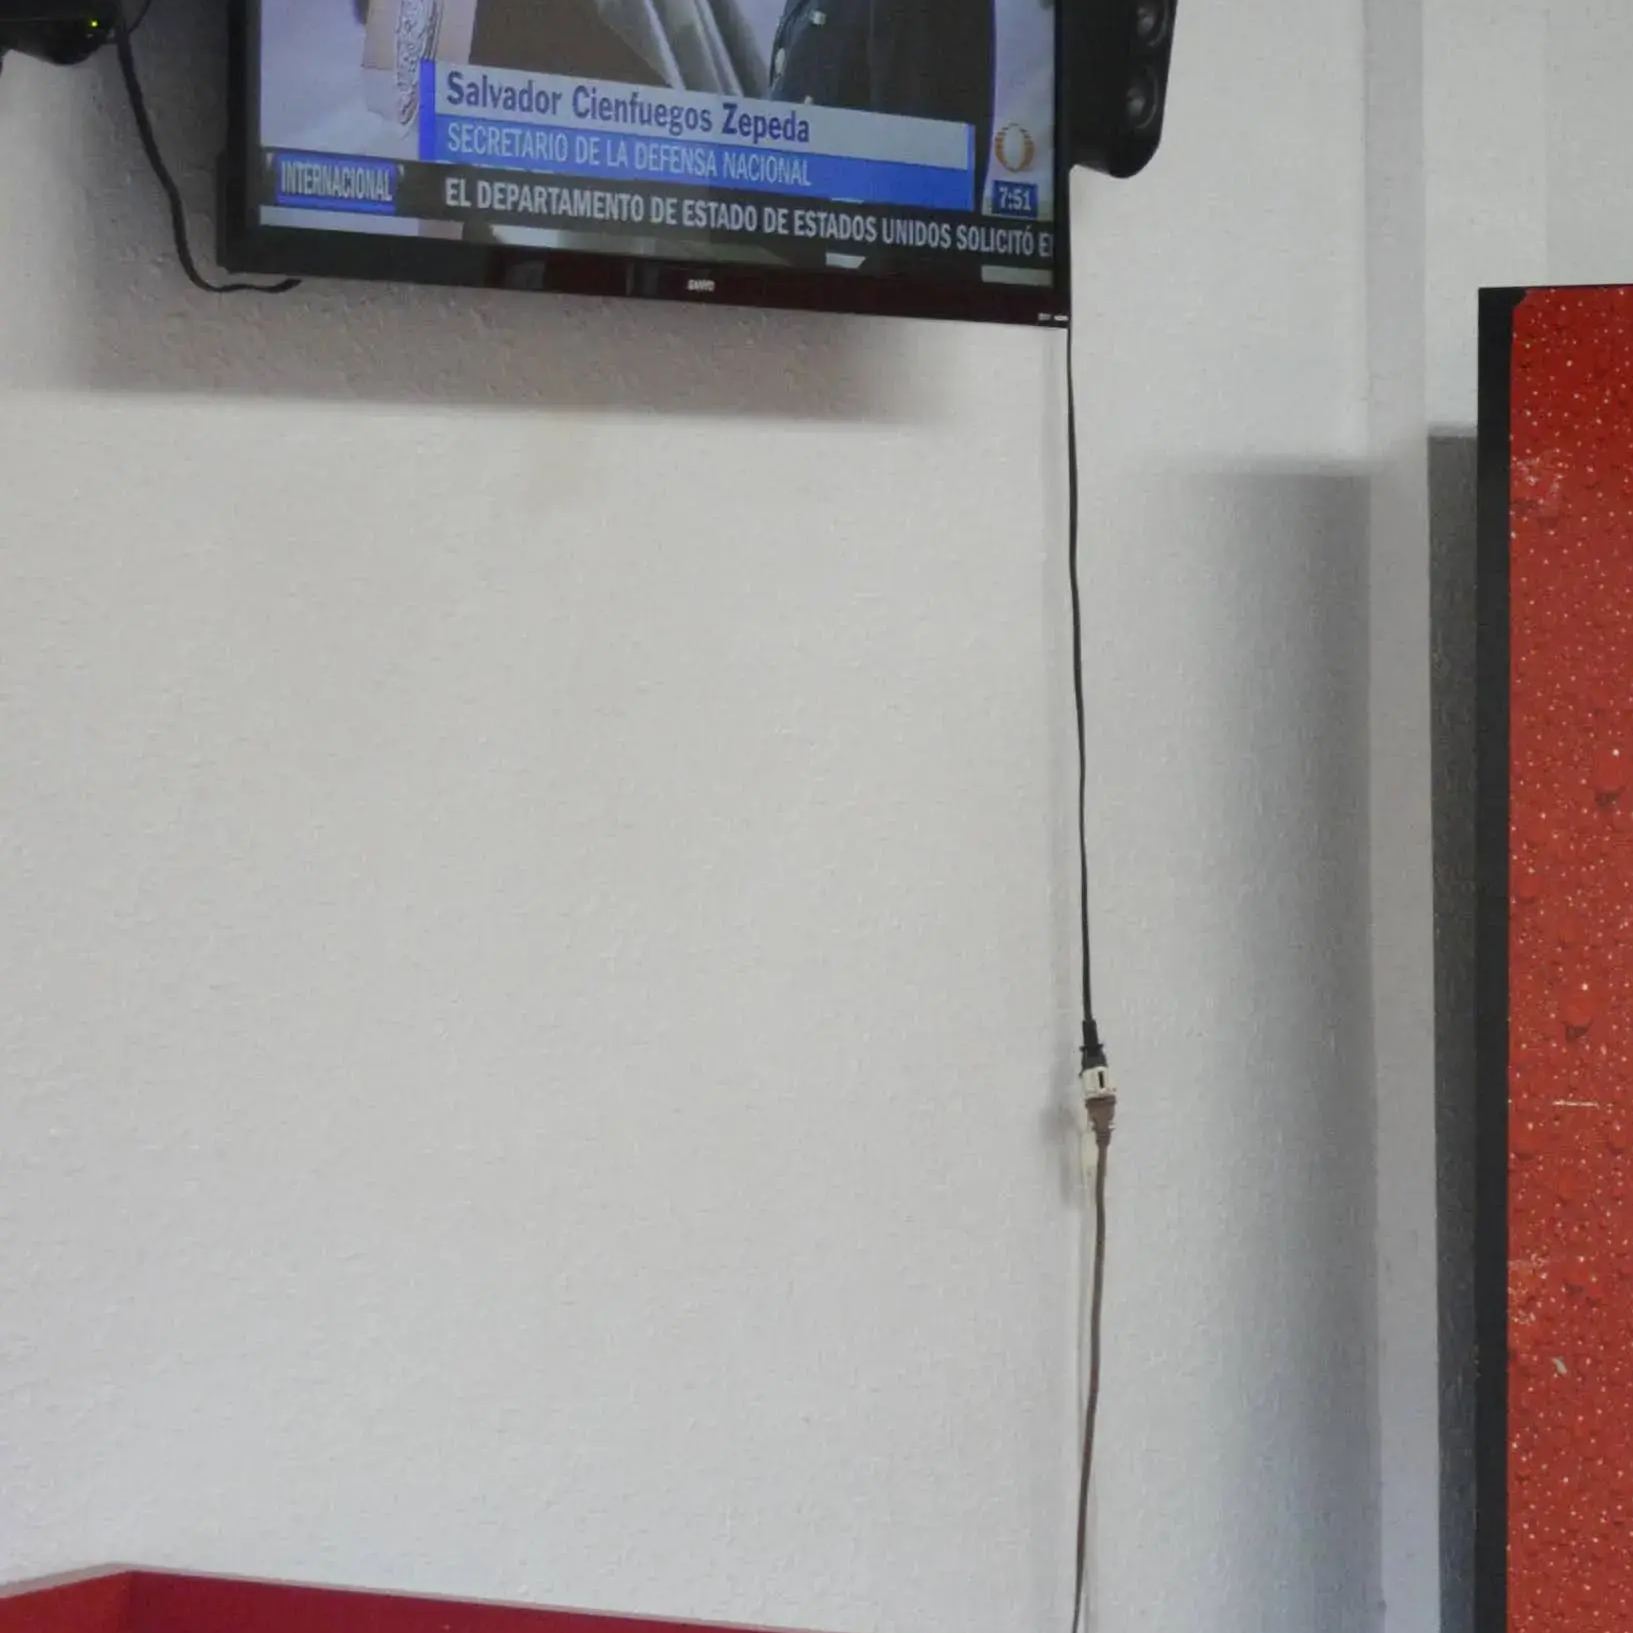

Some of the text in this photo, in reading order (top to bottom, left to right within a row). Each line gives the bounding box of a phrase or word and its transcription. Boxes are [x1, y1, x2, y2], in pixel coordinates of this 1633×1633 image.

[446, 70, 811, 145] Salvador Cienfuegos Zepeda
[280, 160, 393, 202] INTERNACIONAL
[447, 122, 812, 187] SECRETARIO DE LA DEFENSA NACIONAL
[445, 179, 472, 208] EL
[477, 180, 644, 223] DEPARTAMENTO
[650, 196, 678, 225] DE
[684, 199, 758, 232] ESTADO
[763, 206, 787, 235] DE
[793, 210, 878, 243] ESTADOS
[882, 217, 953, 250] UNIDOS
[956, 223, 1034, 256] SOLICITÓ
[998, 185, 1034, 213] 7:51
